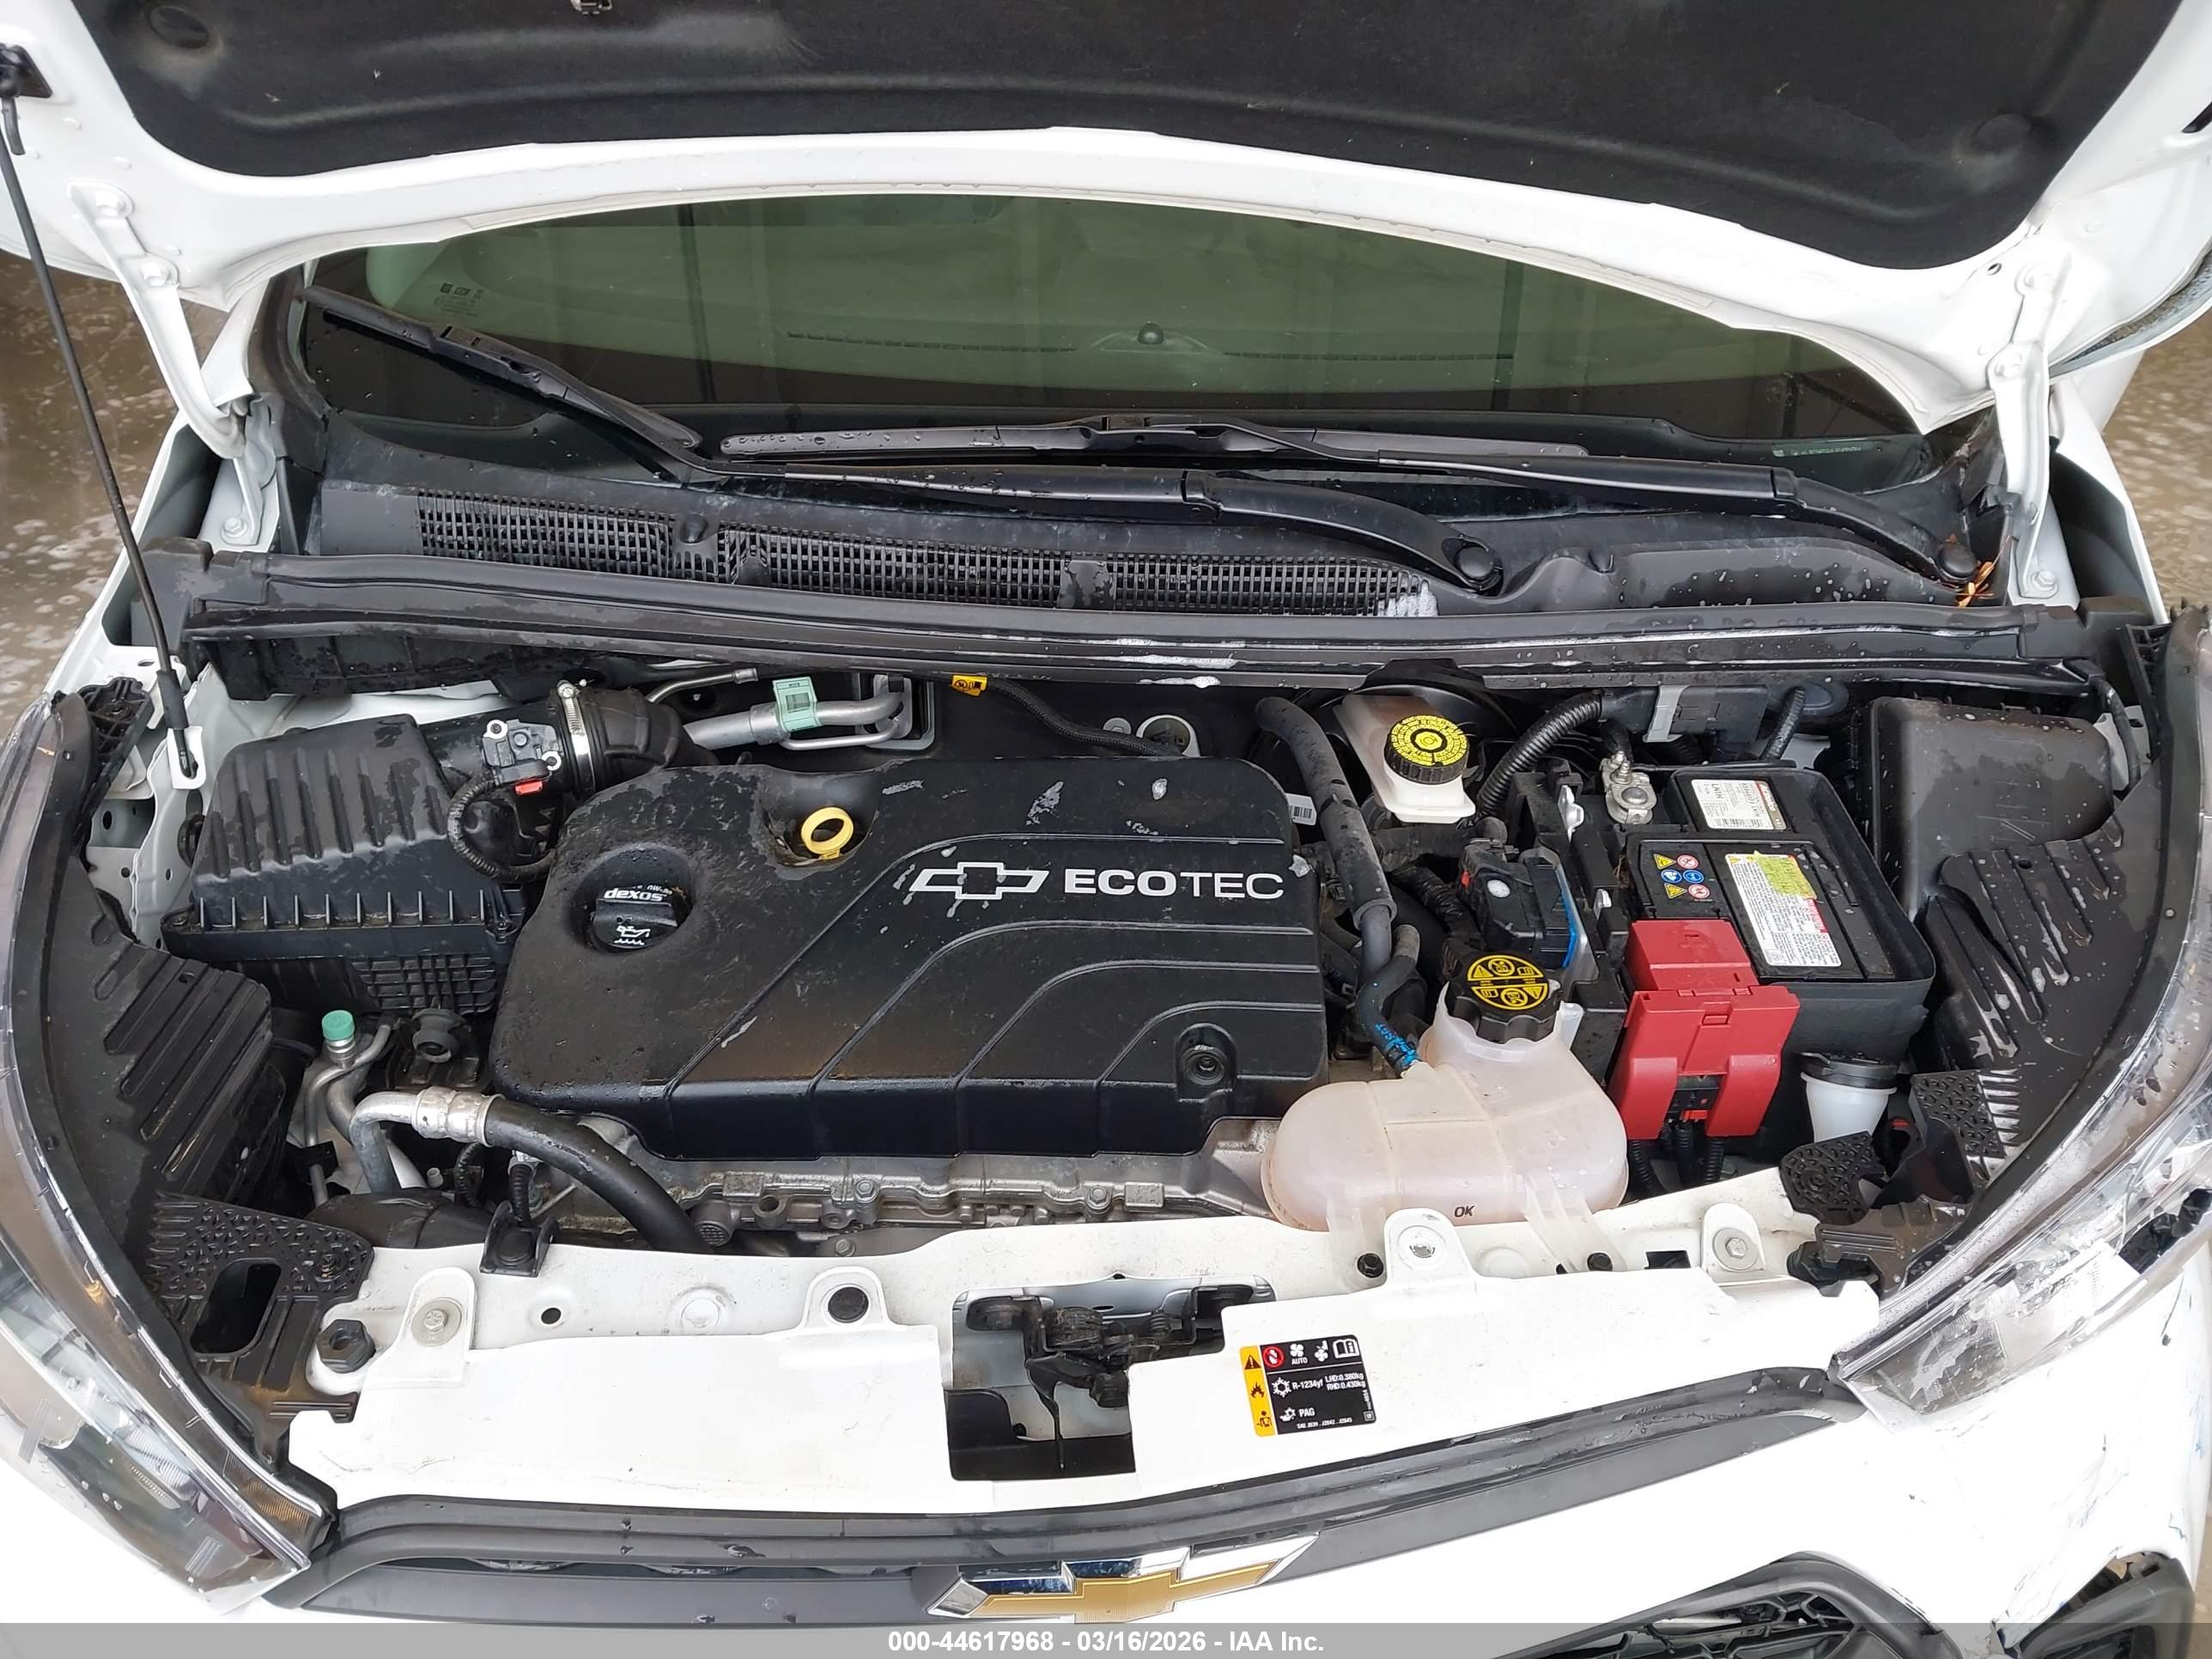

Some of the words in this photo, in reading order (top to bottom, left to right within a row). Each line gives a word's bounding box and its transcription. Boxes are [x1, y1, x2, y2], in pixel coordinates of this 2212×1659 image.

[1065, 868, 1285, 899] ECOTEC
[604, 888, 667, 902] dexos
[1454, 1205, 1475, 1218] OK
[1291, 1357, 1308, 1365] AUTO
[1292, 1379, 1323, 1389] R-1234yf
[1299, 1407, 1316, 1418] PAG
